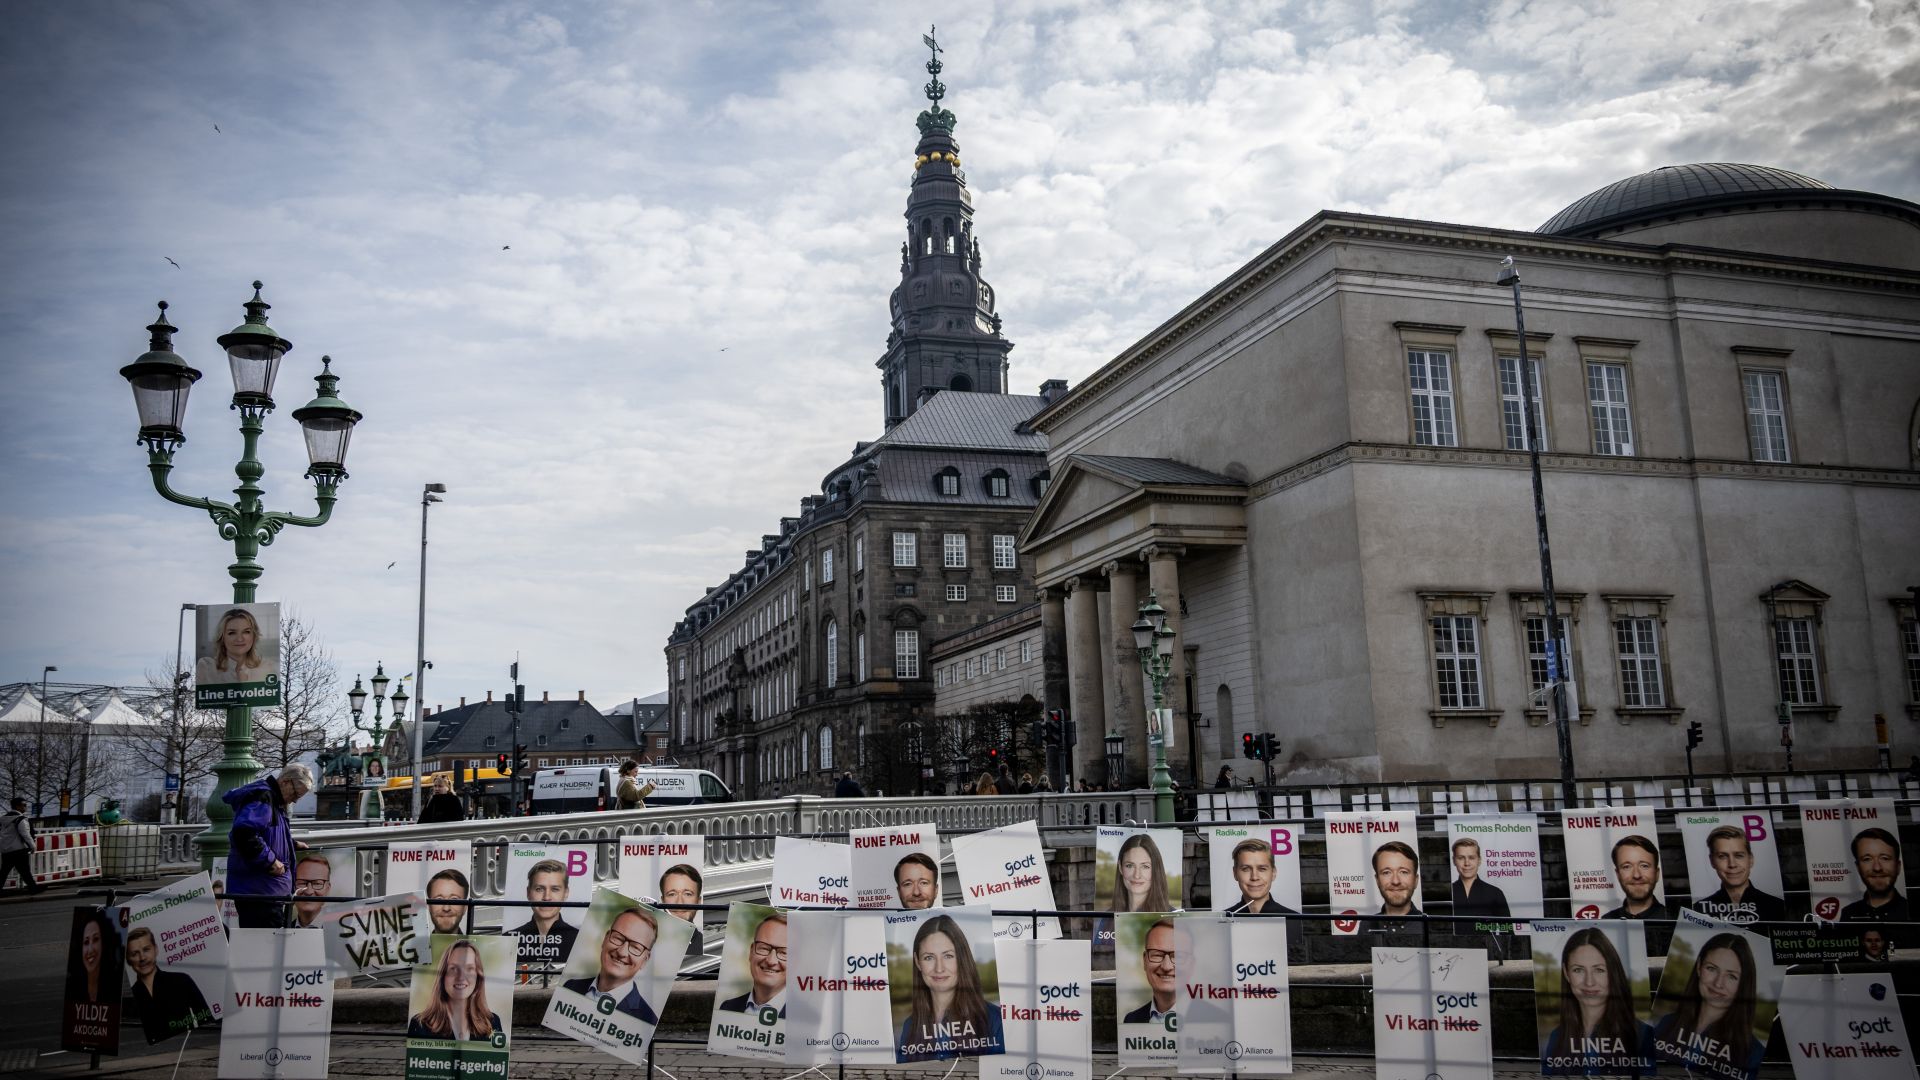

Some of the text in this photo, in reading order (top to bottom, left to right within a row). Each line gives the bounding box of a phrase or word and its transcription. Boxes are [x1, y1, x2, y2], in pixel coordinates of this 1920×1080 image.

[198, 687, 278, 700] Line Ervolder
[1568, 815, 1638, 828] RUNE PALM
[1806, 808, 1878, 820] RUNE PALM
[1330, 822, 1399, 834] RUNE PALM
[1454, 824, 1532, 832] Thomas Rohden
[1743, 815, 1767, 842] B
[855, 833, 920, 848] RUNE PALM
[1270, 828, 1292, 855] B
[392, 850, 456, 862] RUNE PALM
[624, 844, 688, 856] RUNE PALM
[1486, 850, 1536, 858] Din stemme
[566, 850, 588, 876] B
[1005, 854, 1036, 876] godt
[1487, 869, 1522, 878] psykiatri
[818, 876, 848, 890] godt
[970, 874, 1041, 899] Vi kan ikke
[164, 886, 206, 909] Rohden
[780, 888, 848, 906] Vi kan ikke
[1699, 900, 1757, 913] Thomas
[1821, 903, 1836, 914] SF
[886, 915, 917, 924] Venstre
[1475, 922, 1513, 931] Radikale
[1516, 922, 1522, 930] B
[1683, 910, 1714, 928] Venstre
[160, 928, 177, 942] Din
[178, 914, 216, 938] stemme
[1534, 924, 1566, 932] Venstre
[1800, 930, 1816, 938] møg
[164, 924, 220, 953] for en bedre
[508, 931, 562, 957] Thomas ohden
[1774, 936, 1860, 949] Rent Øresund
[167, 941, 206, 965] psykiatri
[1776, 952, 1794, 960] Stem
[1822, 950, 1860, 960] Storgaard
[847, 952, 886, 974] godt
[1236, 960, 1276, 982] godt
[285, 970, 324, 990] godt
[797, 976, 886, 992] Vi kan ikke
[236, 992, 322, 1007] Vi kan ikke
[1040, 982, 1080, 1004] godt
[1186, 984, 1278, 999] Vi kan ikke
[212, 1004, 221, 1014] B
[1436, 992, 1478, 1014] godt
[75, 1002, 109, 1022] YILDIZ
[1012, 1005, 1080, 1022] kan ikke
[554, 1000, 606, 1034] Nikolaj
[606, 1022, 643, 1048] Bøgh
[922, 1020, 976, 1040] LINEA
[1386, 1014, 1480, 1032] Vi kan ikke
[1848, 1016, 1894, 1040] godt
[494, 1036, 502, 1046] C
[716, 1024, 772, 1046] Nikolaj
[806, 1038, 880, 1046] Liberal LA Alliance
[1125, 1036, 1176, 1050] Nikola
[900, 1036, 1000, 1056] SØGAARD-LIDELL
[1198, 1047, 1223, 1055] Liberal
[1245, 1047, 1274, 1055] Alliance
[1570, 1037, 1626, 1054] LINEA
[1676, 1027, 1732, 1062] LINEA
[1798, 1042, 1900, 1058] Vi kan ikke
[410, 1057, 506, 1076] Helene Fagerhøj
[1546, 1056, 1652, 1068] SØGAARD-LIDELL
[1000, 1068, 1074, 1076] Liberal LA Alliance
